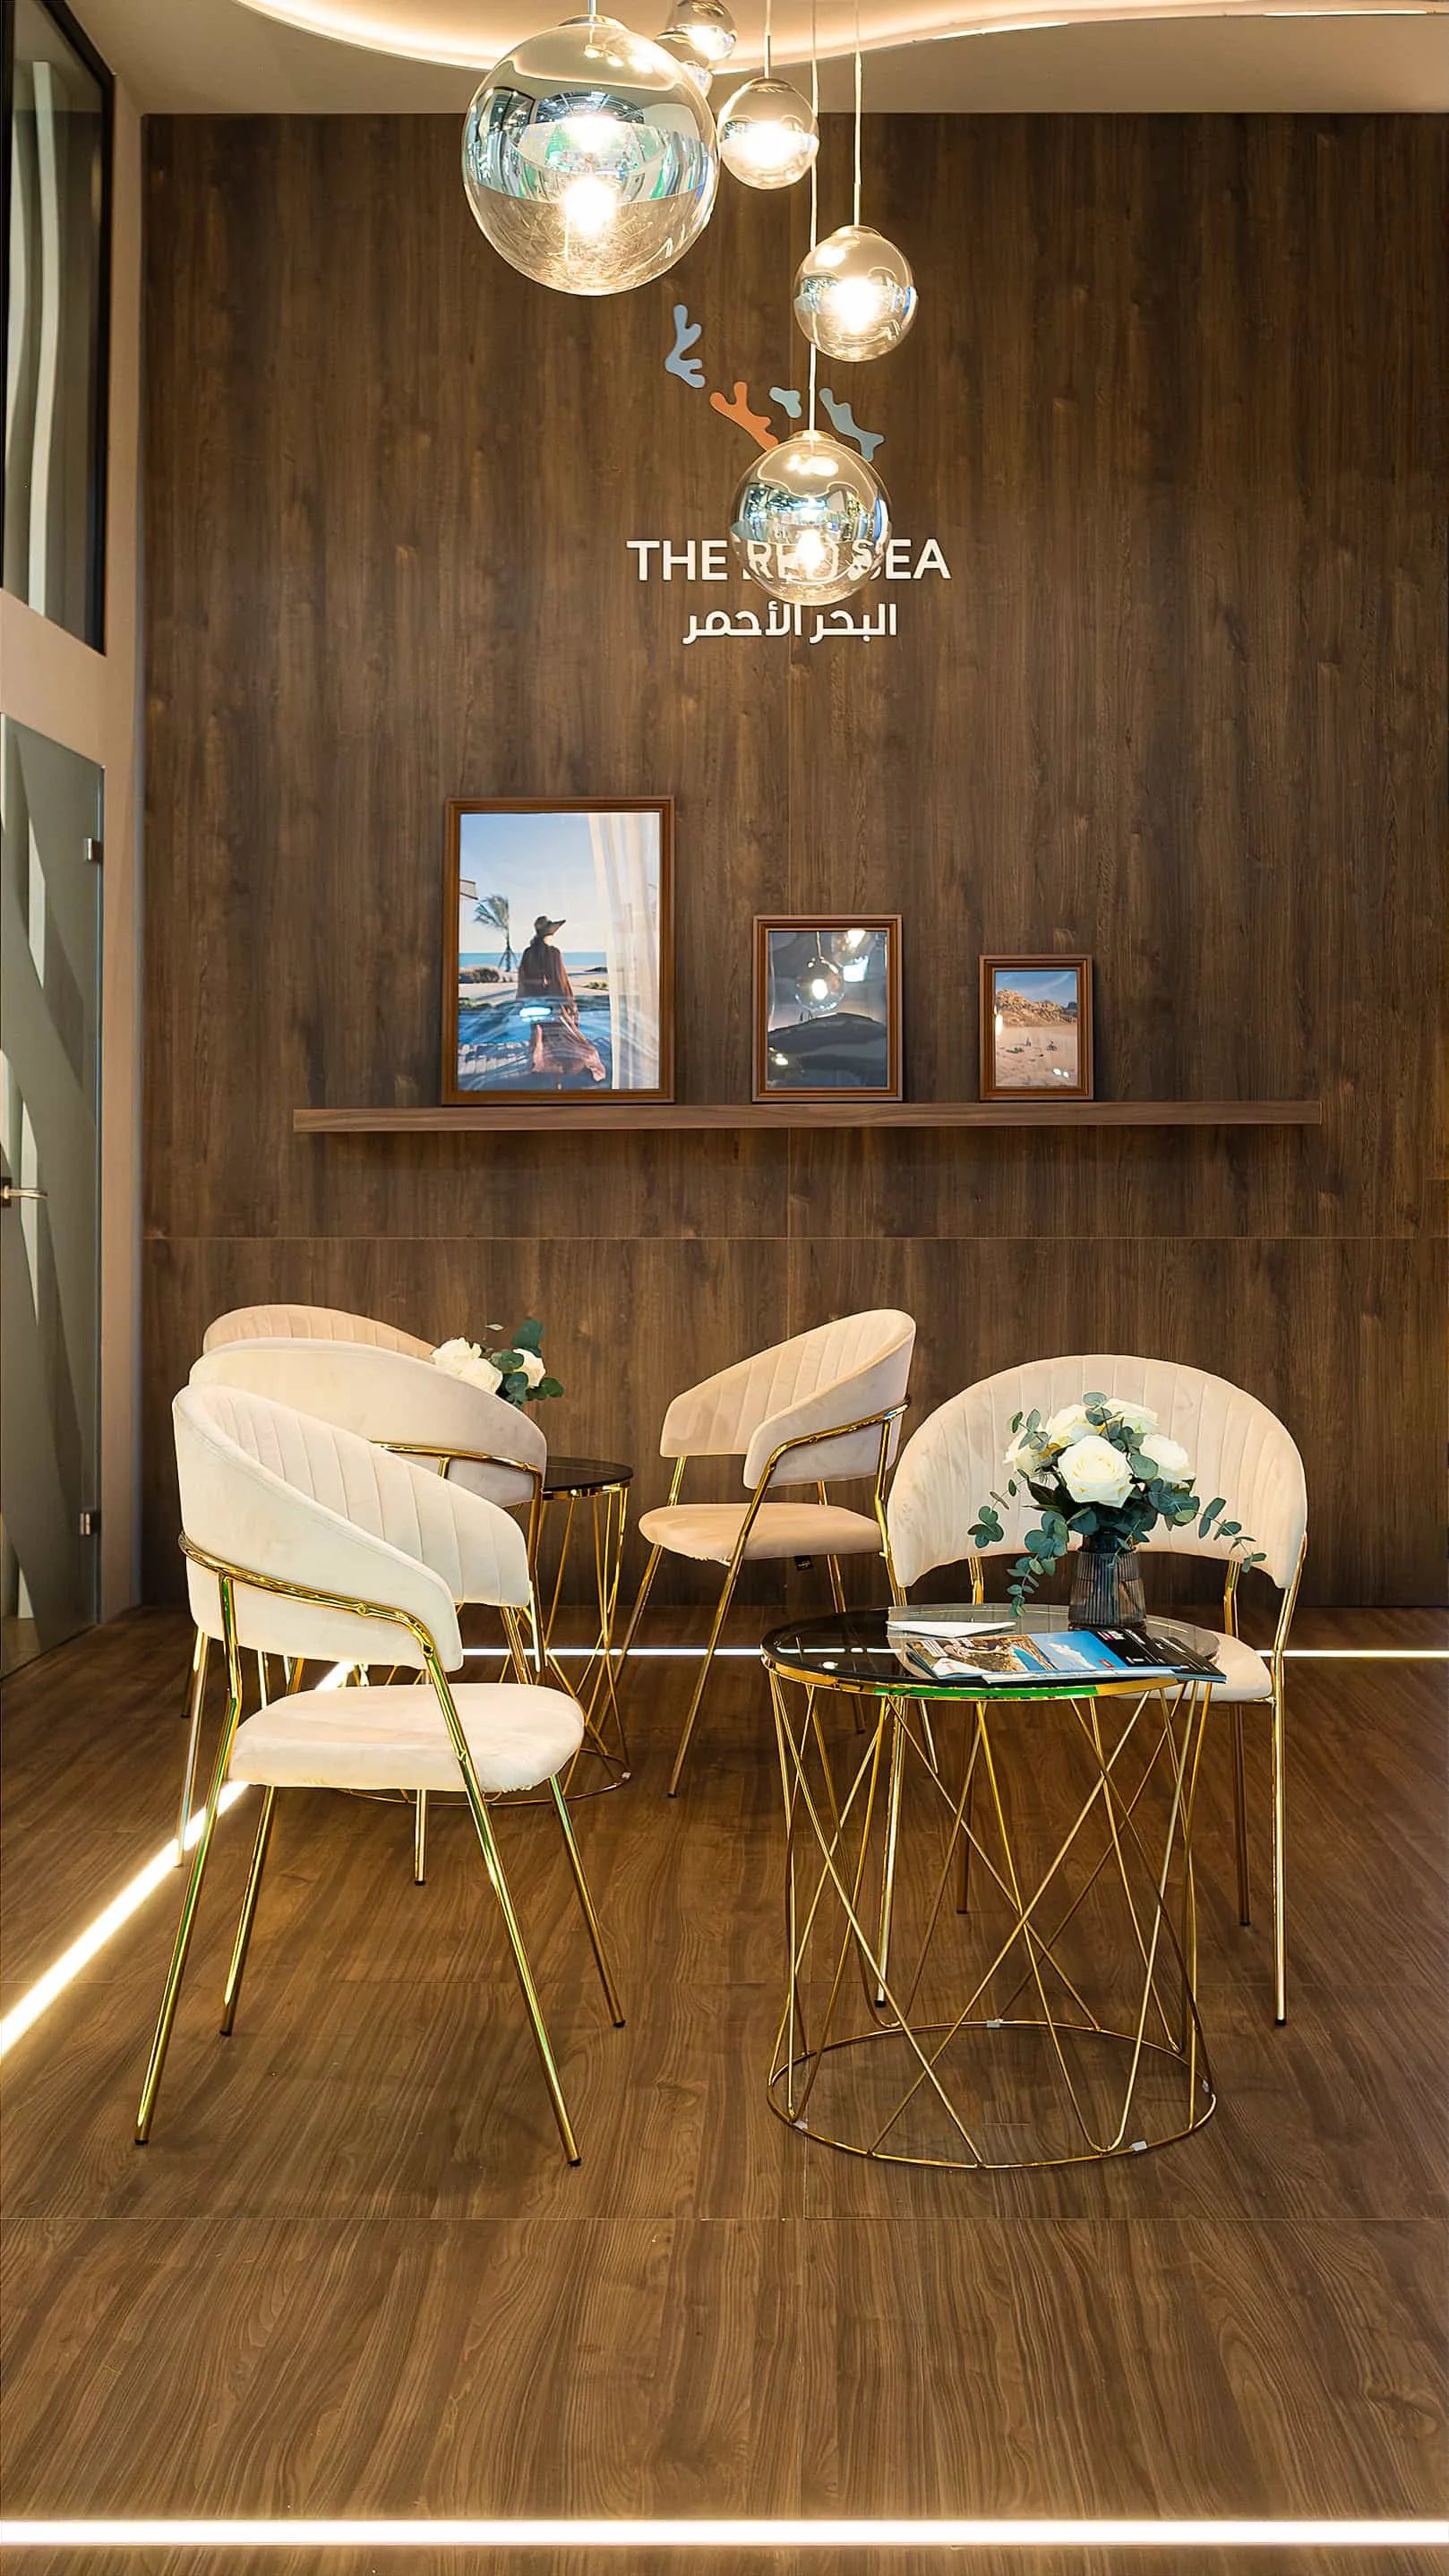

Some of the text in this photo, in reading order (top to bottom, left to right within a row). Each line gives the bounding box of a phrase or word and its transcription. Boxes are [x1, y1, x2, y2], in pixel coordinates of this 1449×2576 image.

[627, 540, 727, 580] THE
[851, 538, 951, 580] SEA
[682, 600, 896, 645] البحر الأحمر
